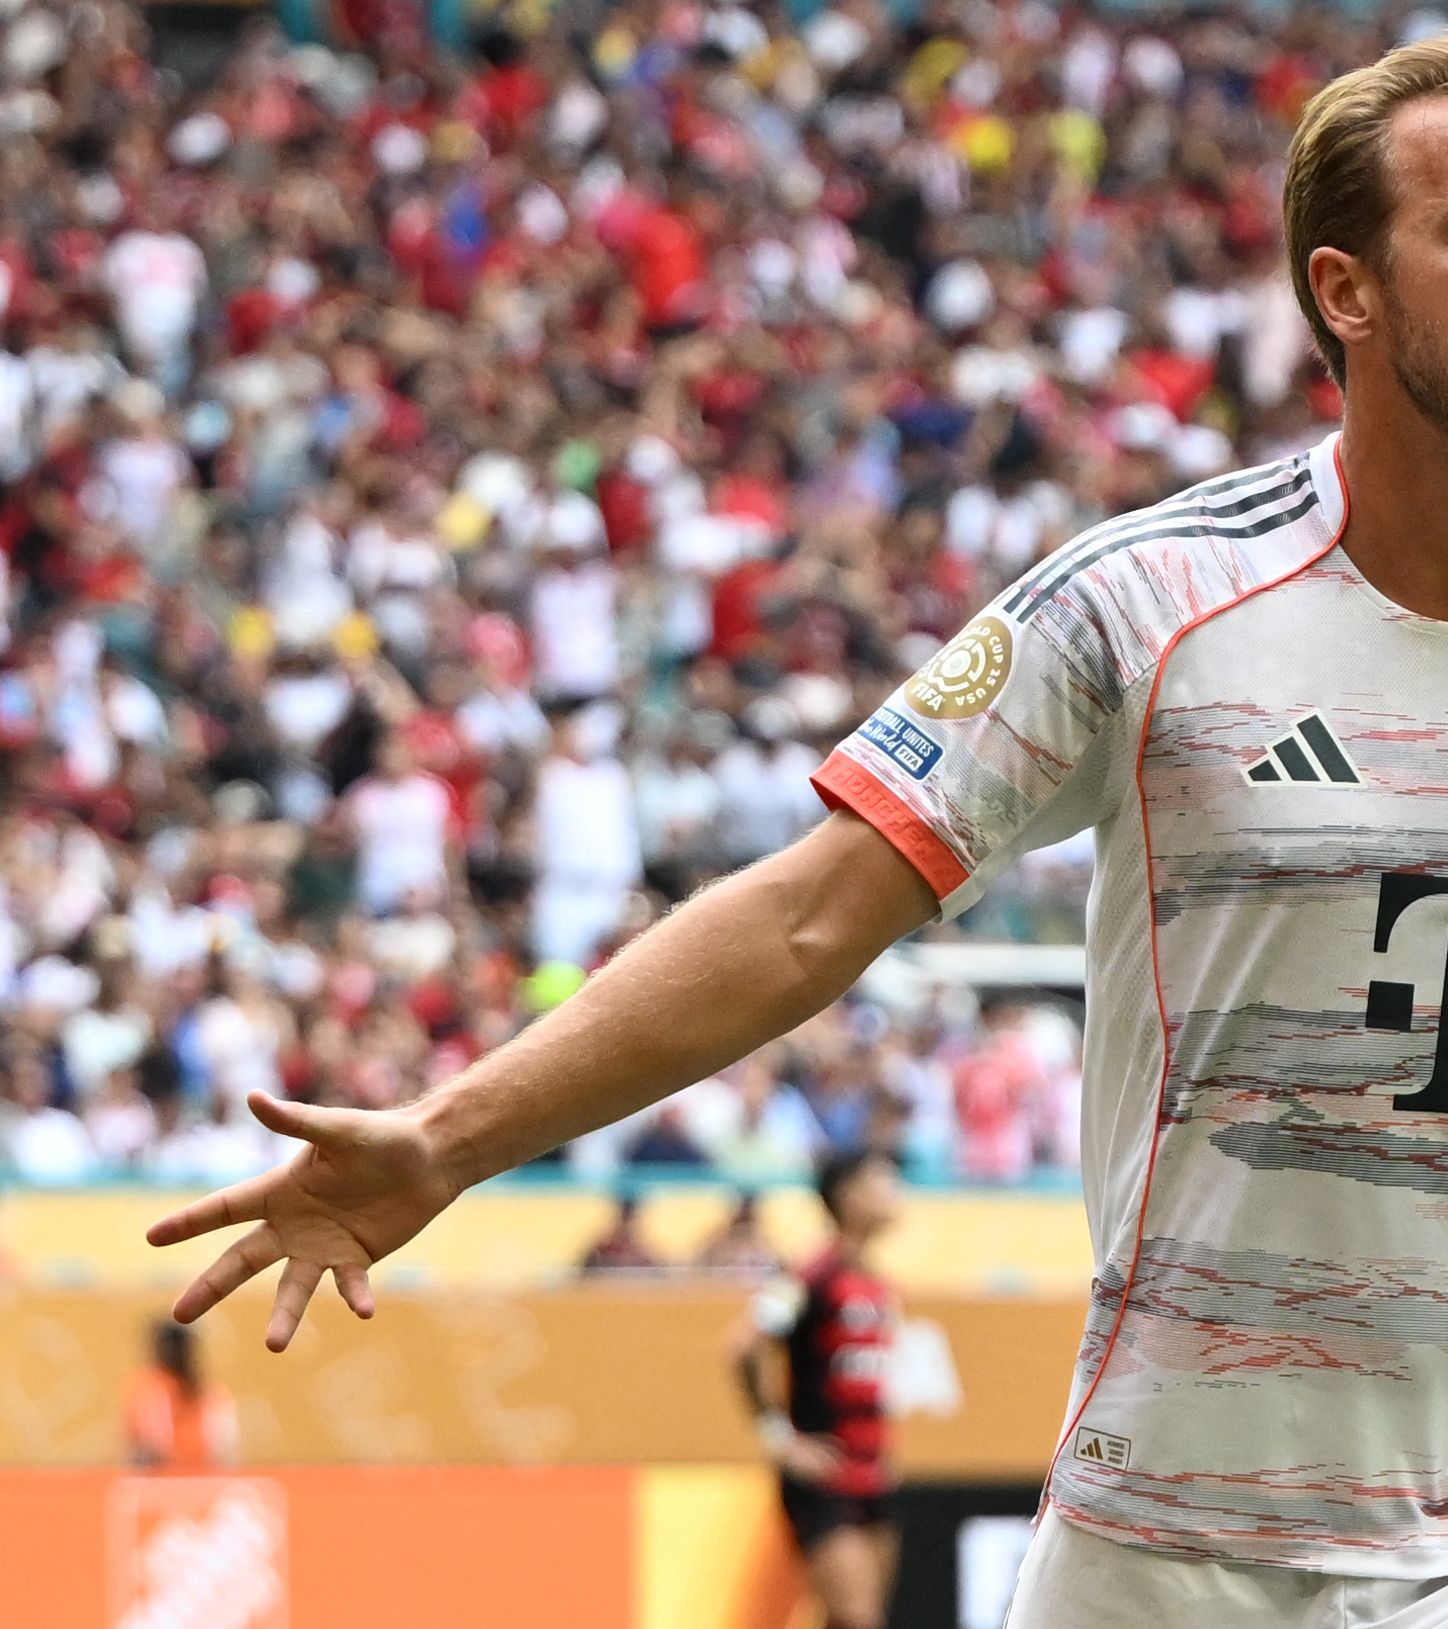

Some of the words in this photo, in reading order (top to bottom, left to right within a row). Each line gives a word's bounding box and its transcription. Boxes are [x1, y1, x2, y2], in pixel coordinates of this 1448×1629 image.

[989, 636, 1004, 664] CUP
[986, 668, 1001, 687] 25
[910, 682, 943, 711] FIFA
[954, 688, 987, 706] USA
[902, 727, 934, 757] UNITES
[899, 748, 919, 768] FIFA
